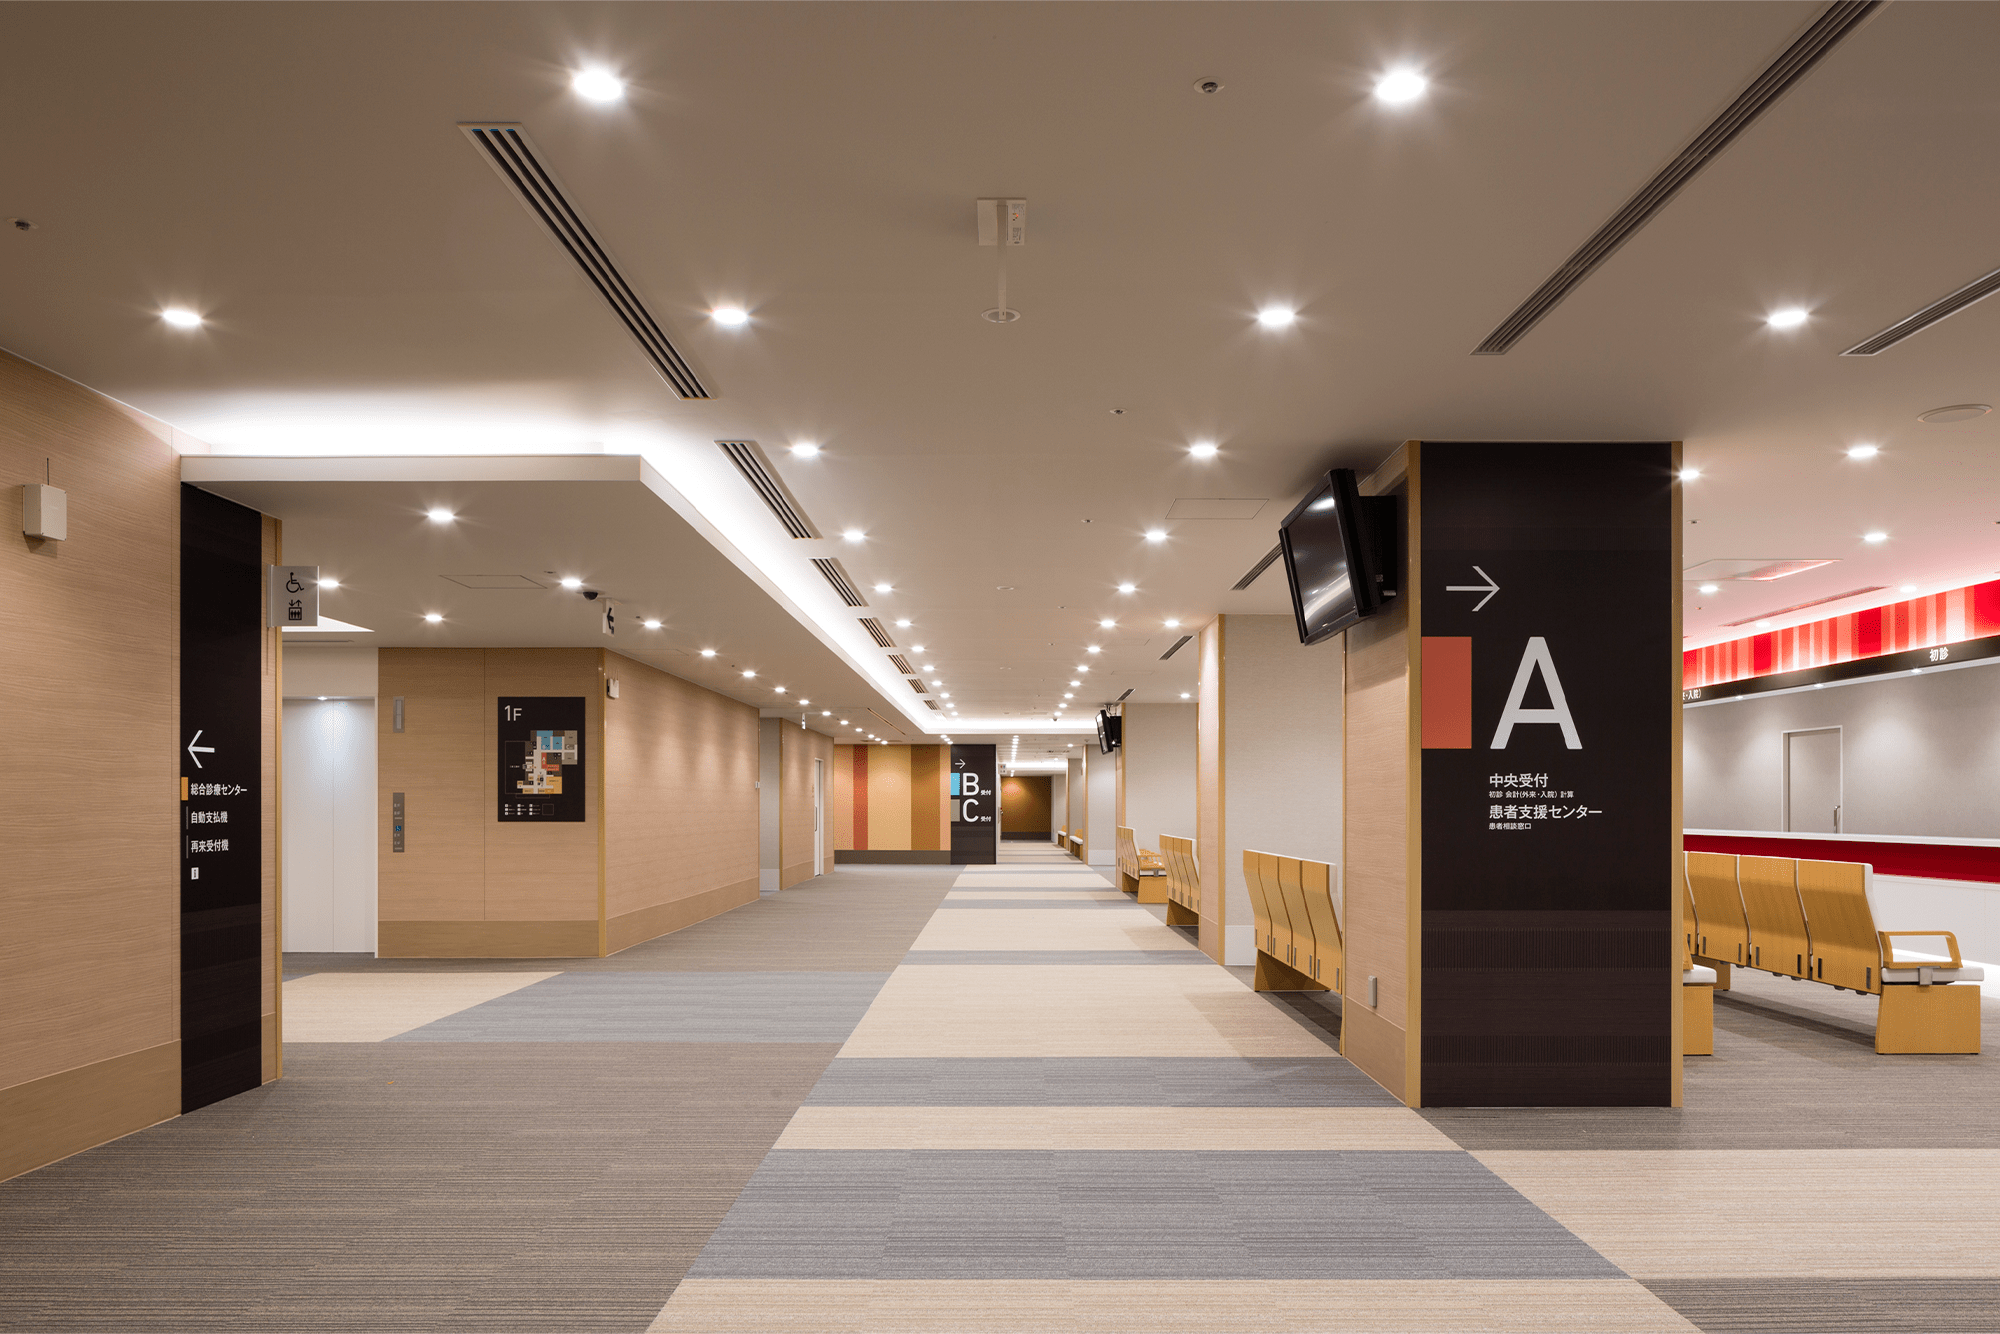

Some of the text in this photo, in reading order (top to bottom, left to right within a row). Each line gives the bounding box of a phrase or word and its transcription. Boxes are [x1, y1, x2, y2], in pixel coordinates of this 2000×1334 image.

[1929, 647, 1949, 662] 初診
[1490, 636, 1583, 750] A
[504, 705, 522, 722] 1F
[962, 772, 980, 796] B
[1489, 772, 1549, 788] 中央受付
[190, 783, 248, 796] 総合診療センター
[190, 810, 228, 824] 自動支払機
[962, 798, 979, 823] C
[1489, 804, 1603, 820] 患者支援センター
[190, 839, 229, 853] 再来受付機
